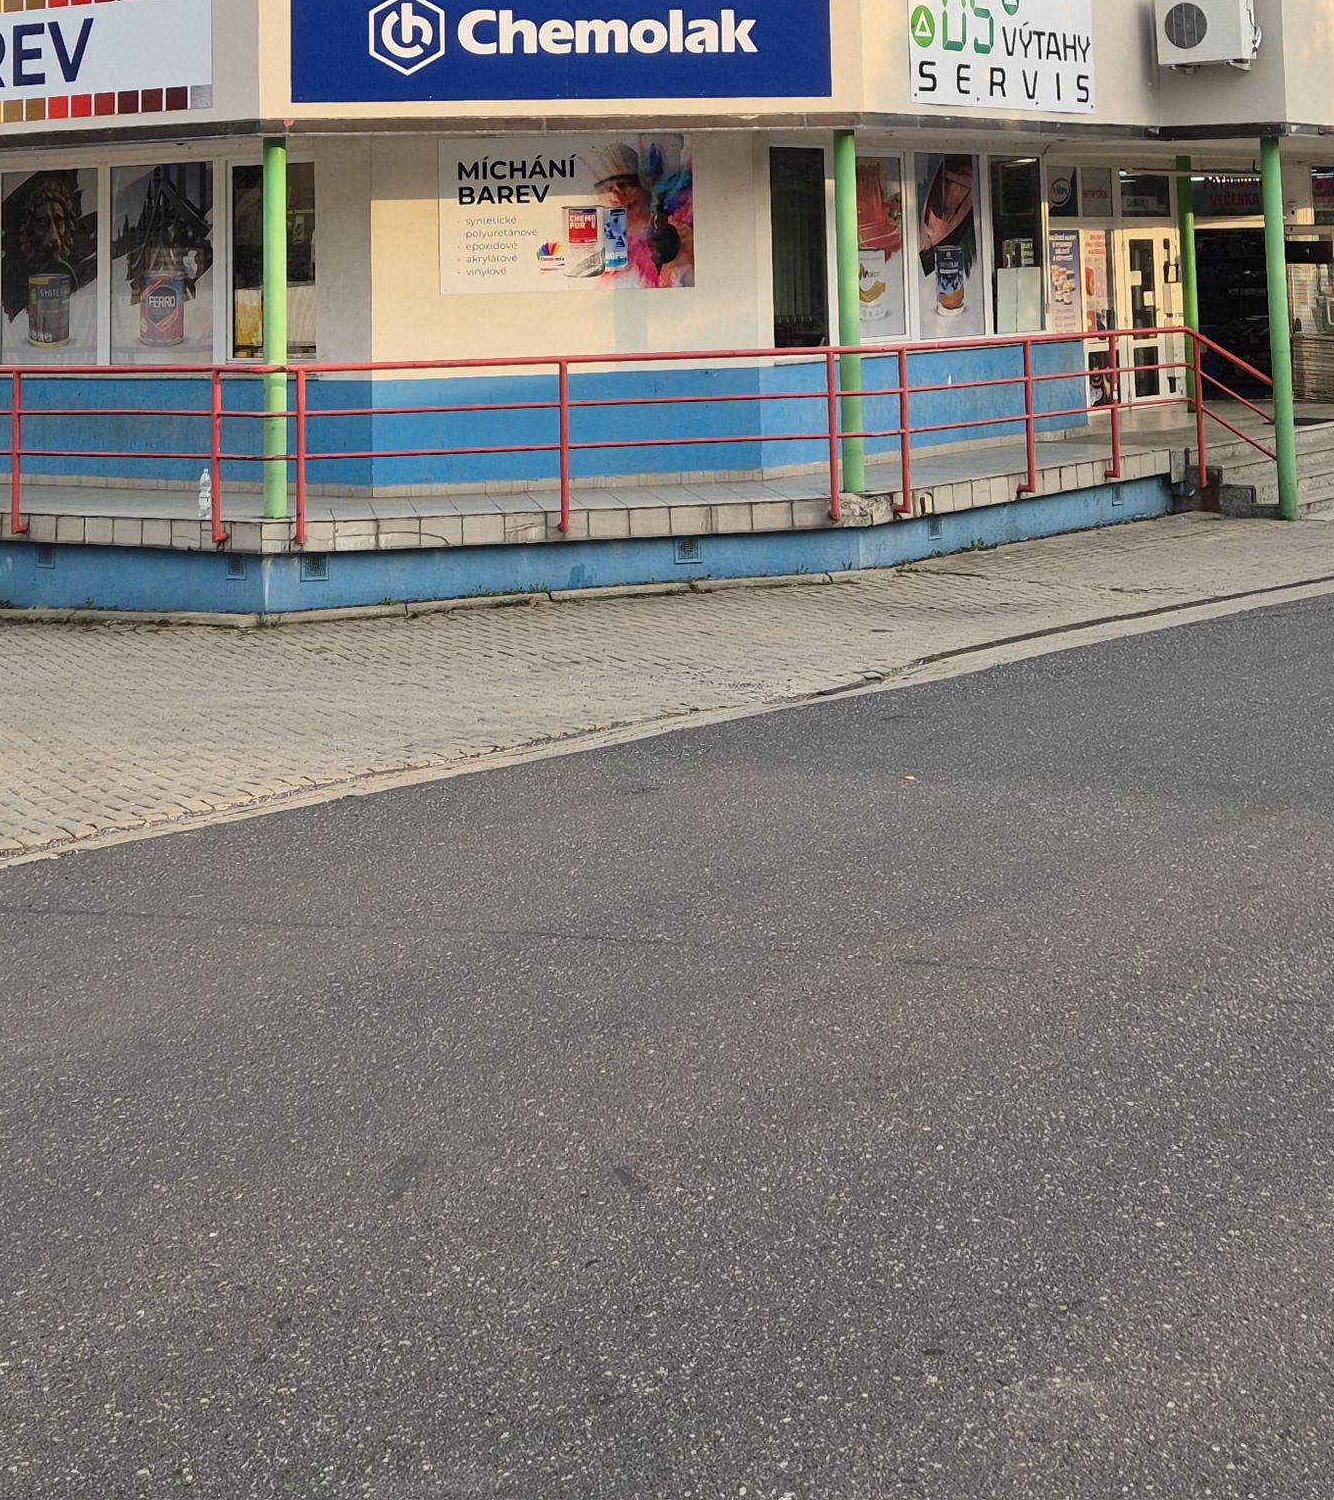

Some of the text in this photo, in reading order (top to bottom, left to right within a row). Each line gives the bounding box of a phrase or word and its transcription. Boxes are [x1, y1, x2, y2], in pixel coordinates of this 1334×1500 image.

[458, 9, 758, 55] Chemolak
[1002, 21, 1091, 63] VÝTAHY
[918, 60, 1090, 103] SERVIS
[457, 154, 576, 181] MÍCHÁNÍ
[458, 184, 550, 205] BAREV
[465, 215, 517, 227] syntetické
[465, 228, 538, 239] polyuretánové
[465, 241, 517, 252] epoxidové
[466, 253, 518, 265] akrylátové
[466, 266, 507, 277] vinylové
